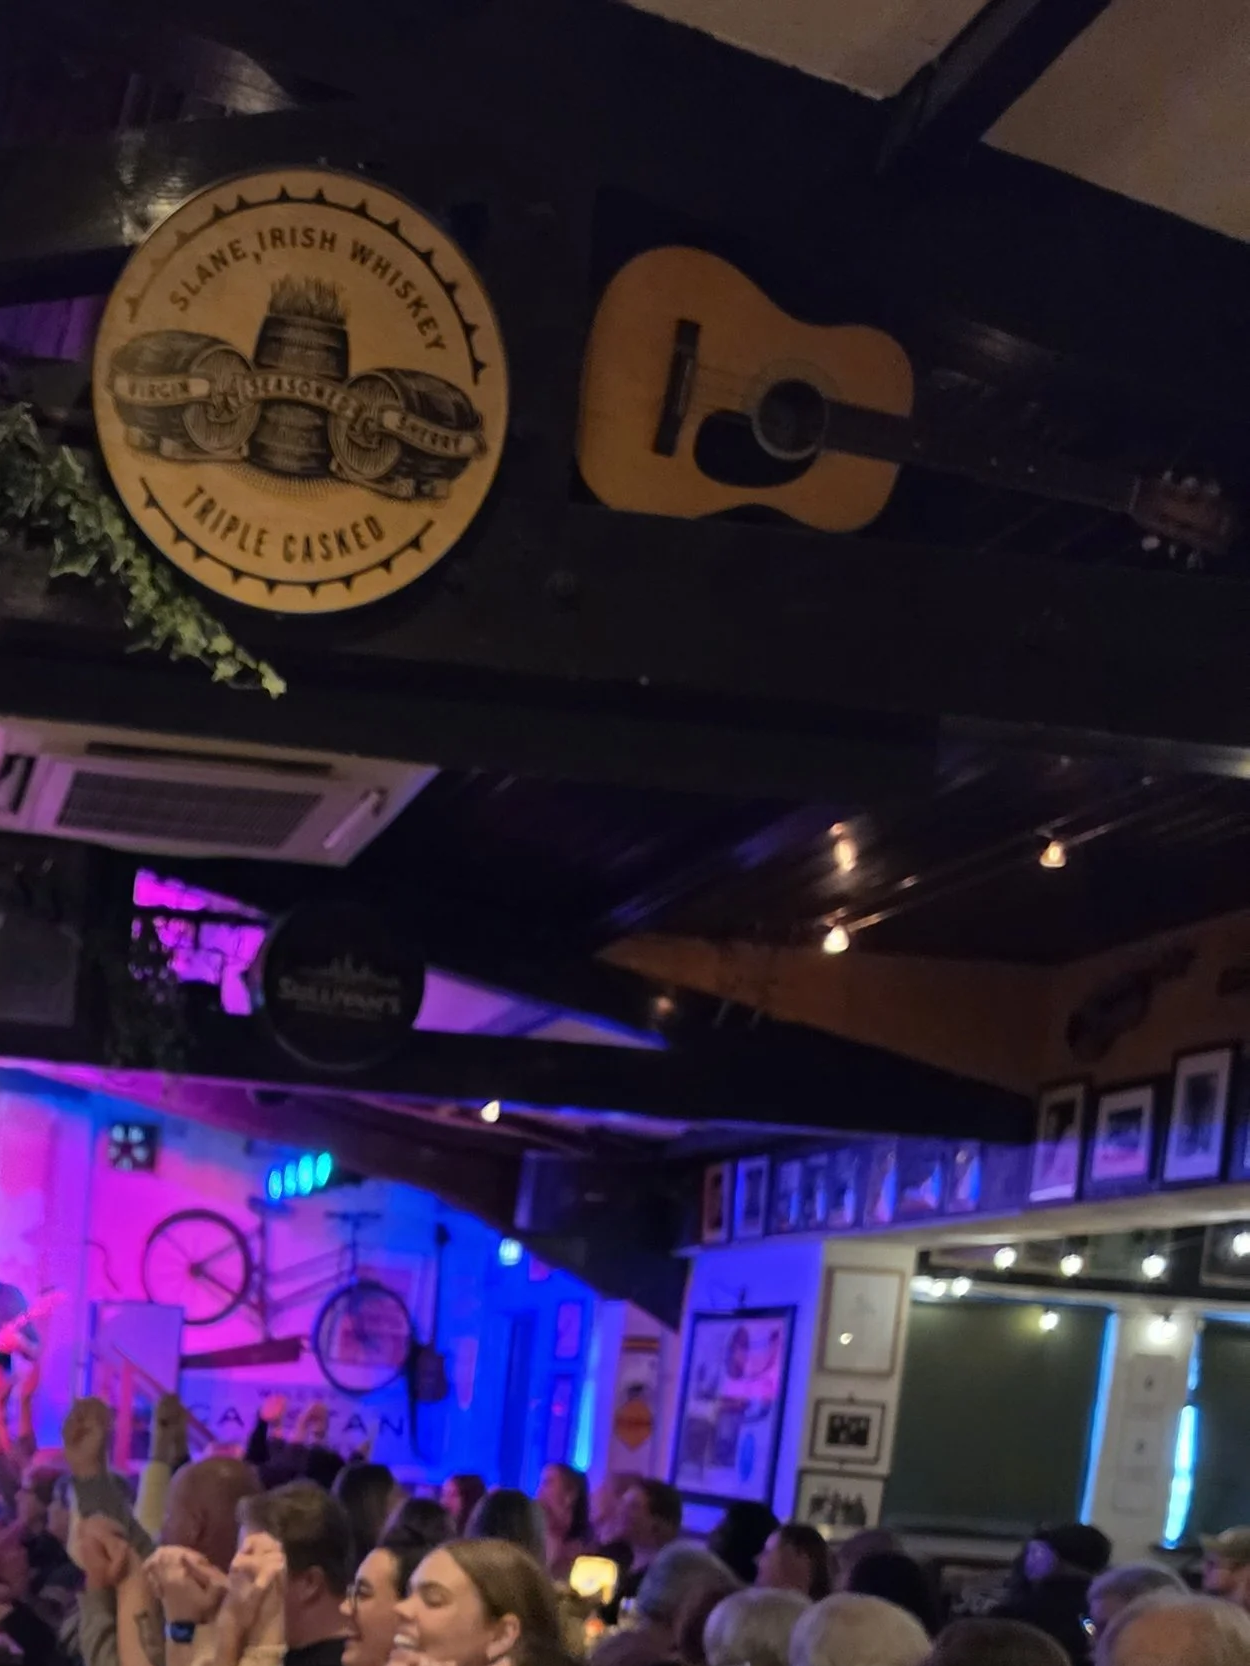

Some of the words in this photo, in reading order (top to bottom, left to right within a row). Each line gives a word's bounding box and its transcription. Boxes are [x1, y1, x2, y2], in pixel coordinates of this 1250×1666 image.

[257, 227, 338, 254] IRISH
[349, 240, 447, 354] WHISKEY
[182, 484, 266, 558] TRIPLE
[282, 514, 386, 565] CASKED
